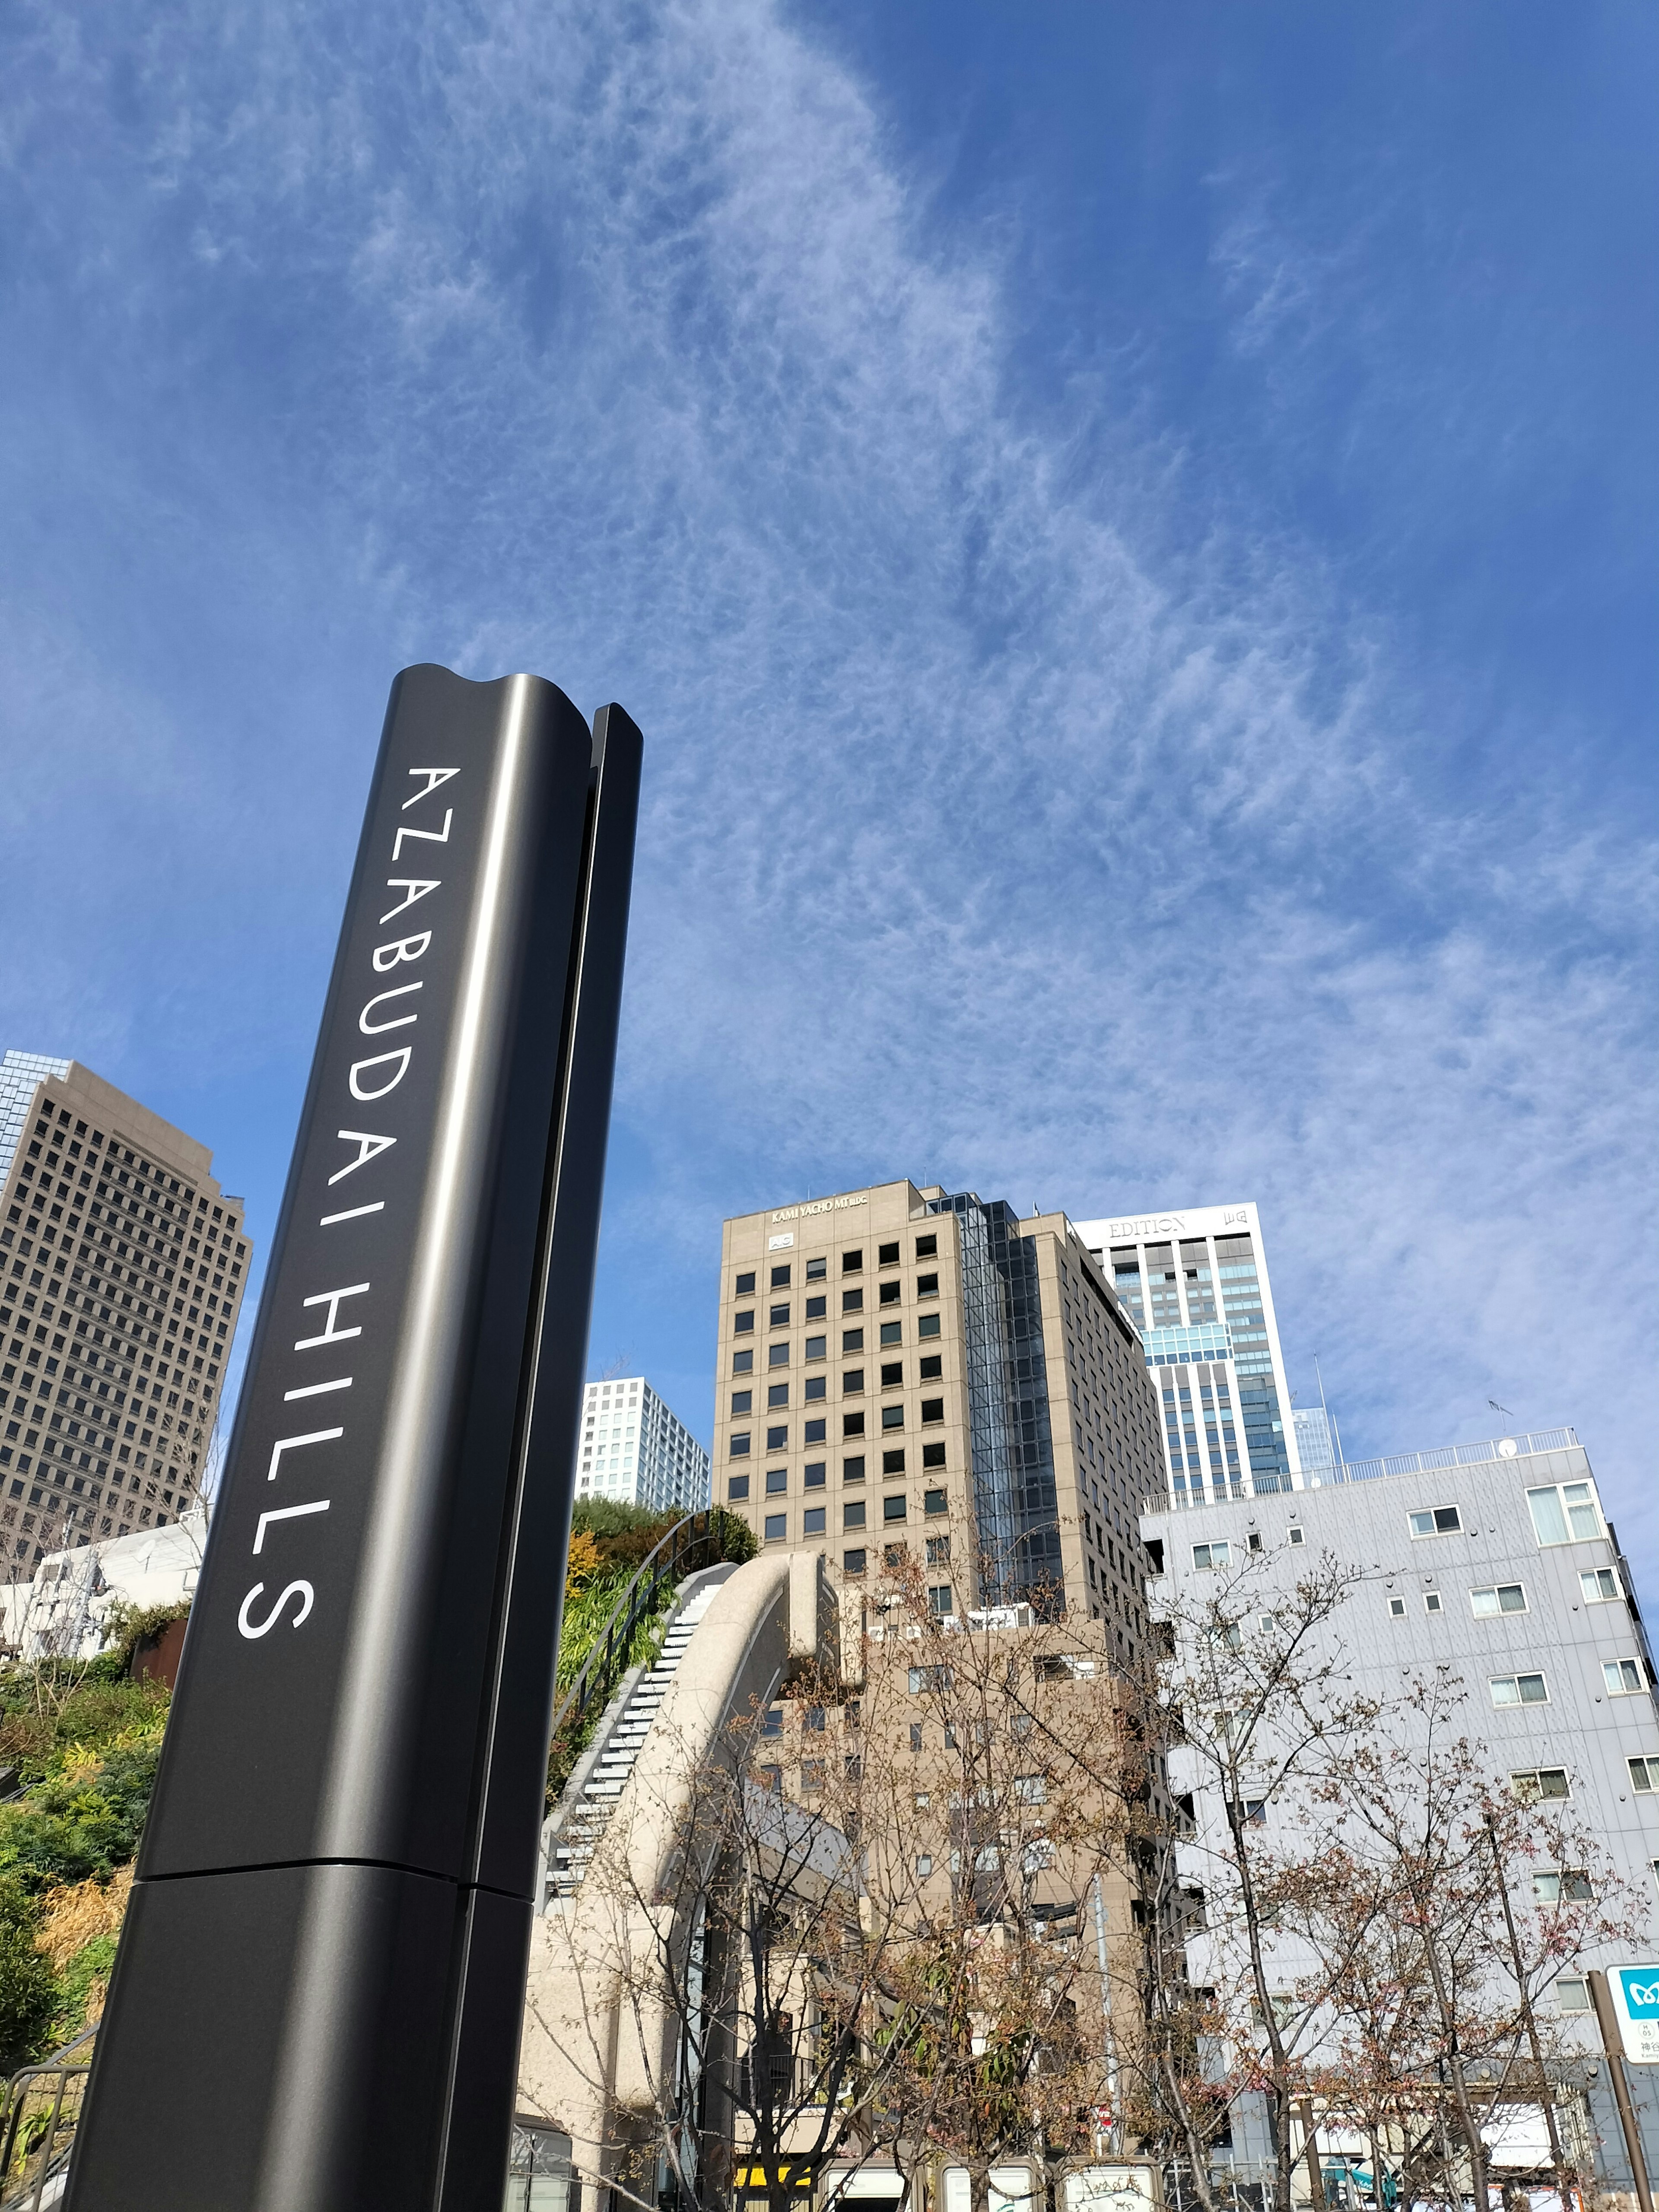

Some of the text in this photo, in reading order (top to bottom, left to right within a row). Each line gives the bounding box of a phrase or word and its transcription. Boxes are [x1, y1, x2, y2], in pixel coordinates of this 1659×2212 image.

[238, 768, 461, 1639] AZABUDAI HILLS
[772, 1208, 798, 1223] KAMI
[800, 1201, 833, 1217] YACHO
[834, 1197, 849, 1209] MT
[1109, 1216, 1185, 1238] EDITION
[771, 1236, 790, 1248] AIG
